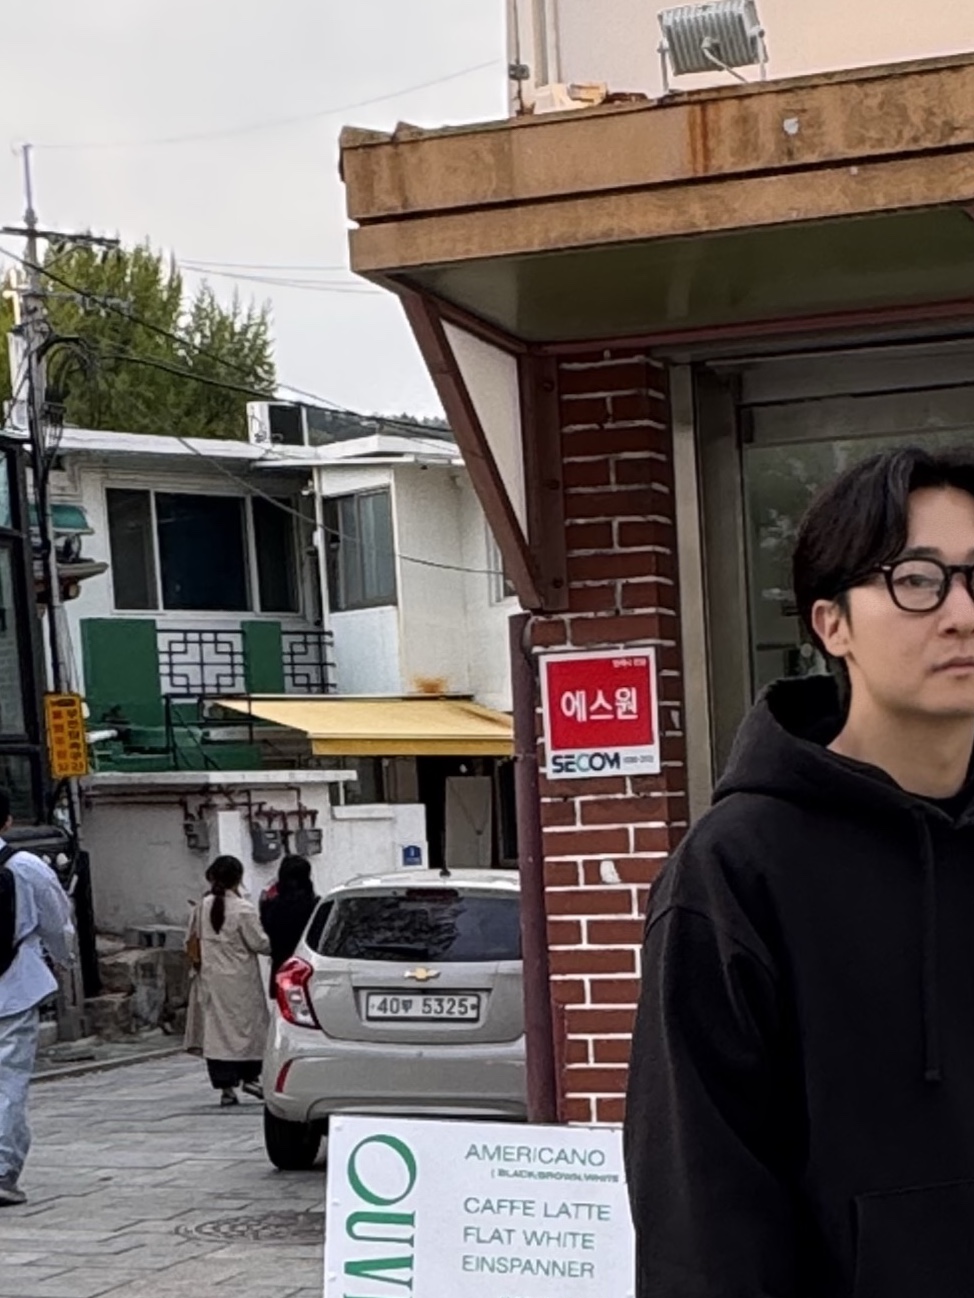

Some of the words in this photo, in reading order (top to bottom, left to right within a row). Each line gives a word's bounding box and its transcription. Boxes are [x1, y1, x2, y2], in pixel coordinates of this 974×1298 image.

[560, 687, 639, 722] 에스원
[551, 752, 621, 773] SECOM
[421, 997, 468, 1015] 5325
[465, 1144, 606, 1167] AMERICANO
[463, 1197, 535, 1218] CAFFE
[543, 1201, 611, 1221] LATTE
[463, 1226, 516, 1246] FLAT
[522, 1229, 595, 1250] WHITE
[462, 1254, 595, 1279] EINSPANNER
